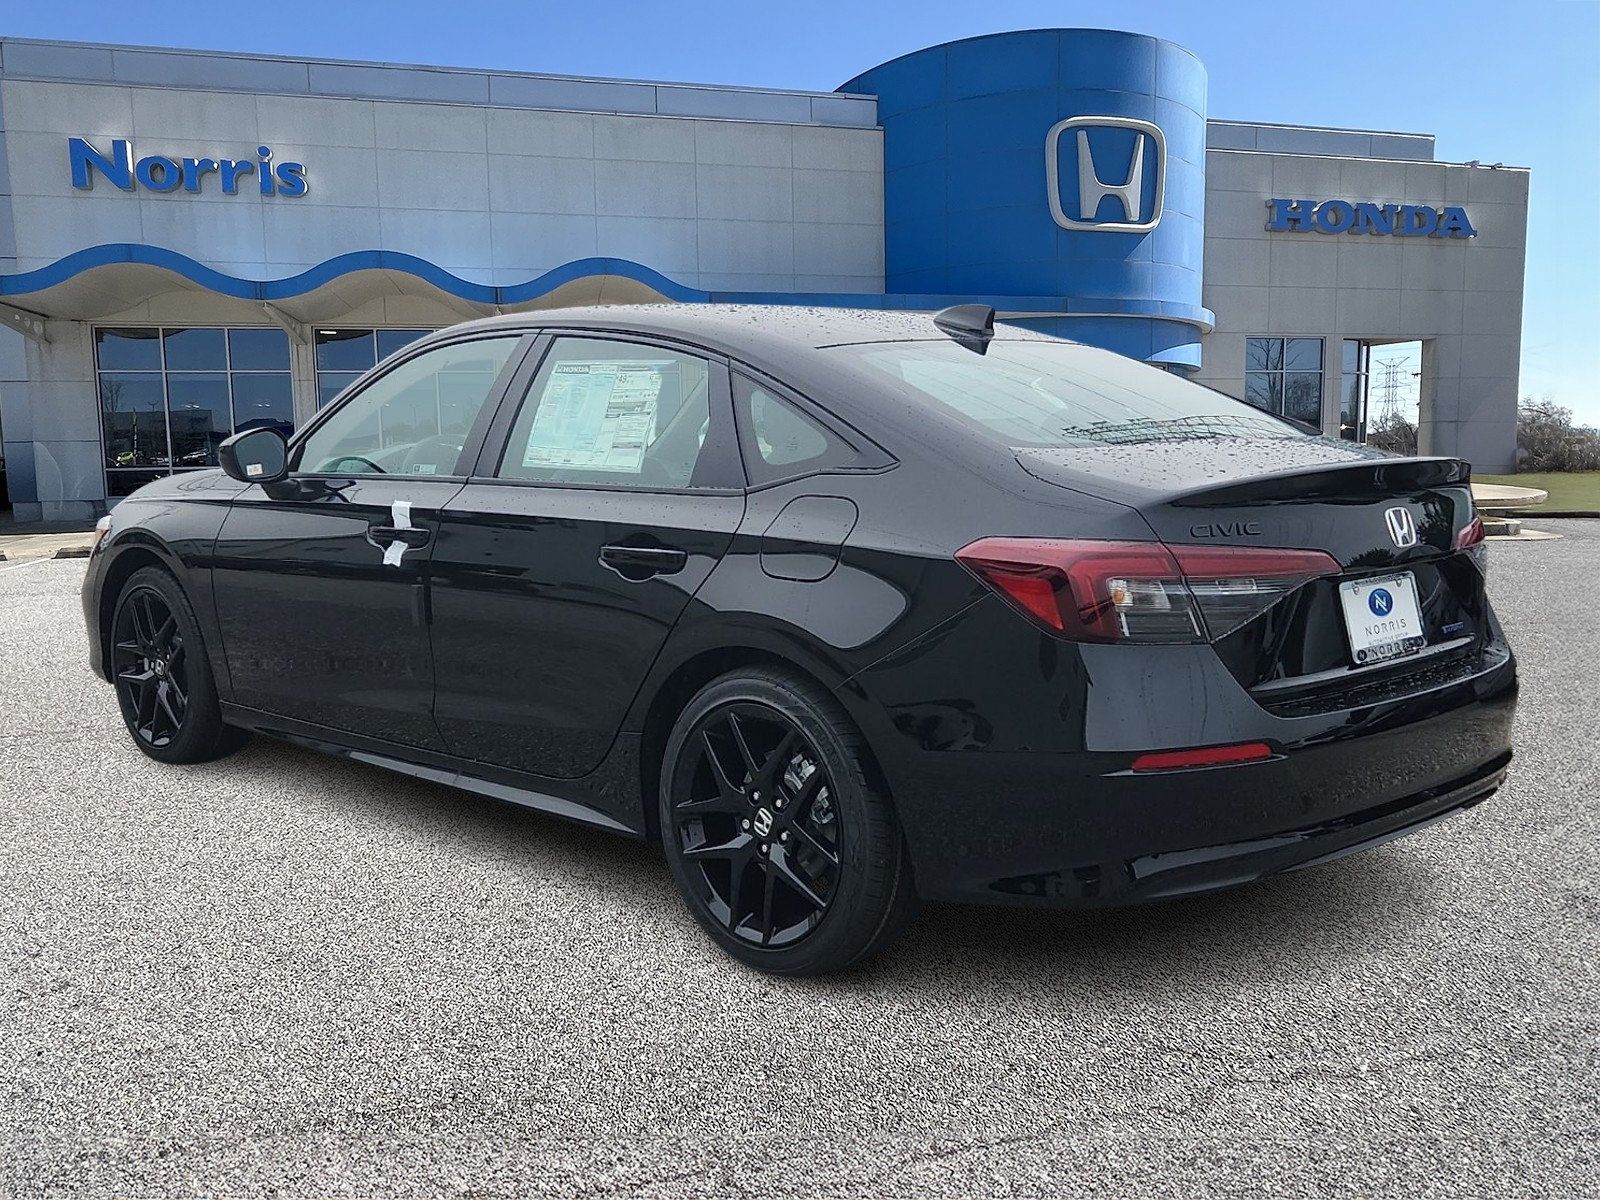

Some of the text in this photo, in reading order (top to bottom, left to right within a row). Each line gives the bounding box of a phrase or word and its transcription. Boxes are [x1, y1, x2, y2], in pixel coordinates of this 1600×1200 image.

[68, 137, 308, 197] Norris
[1265, 198, 1478, 239] HONDA
[563, 366, 590, 374] HONDA
[1189, 522, 1262, 538] CIVIC
[1365, 618, 1407, 636] NORRIS
[1370, 640, 1413, 658] NORR
